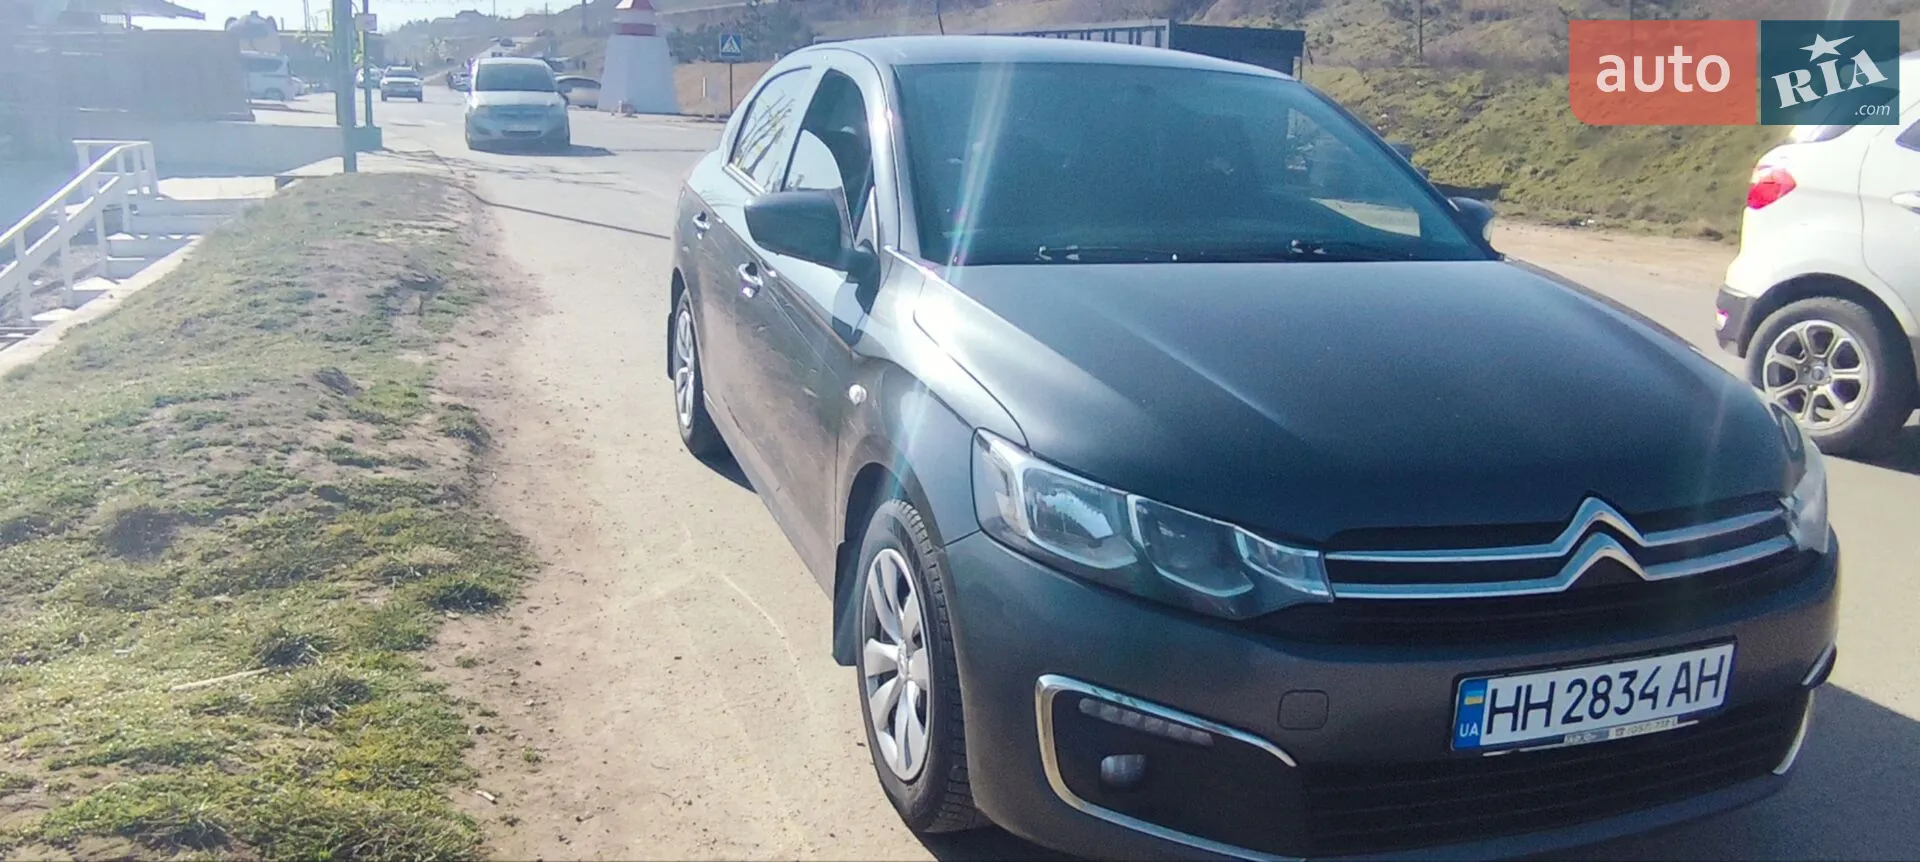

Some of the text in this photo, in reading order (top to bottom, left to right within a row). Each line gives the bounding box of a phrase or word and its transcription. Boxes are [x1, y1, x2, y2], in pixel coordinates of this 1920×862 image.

[1486, 654, 1726, 735] HH 2834 AH
[1459, 723, 1480, 738] UA
